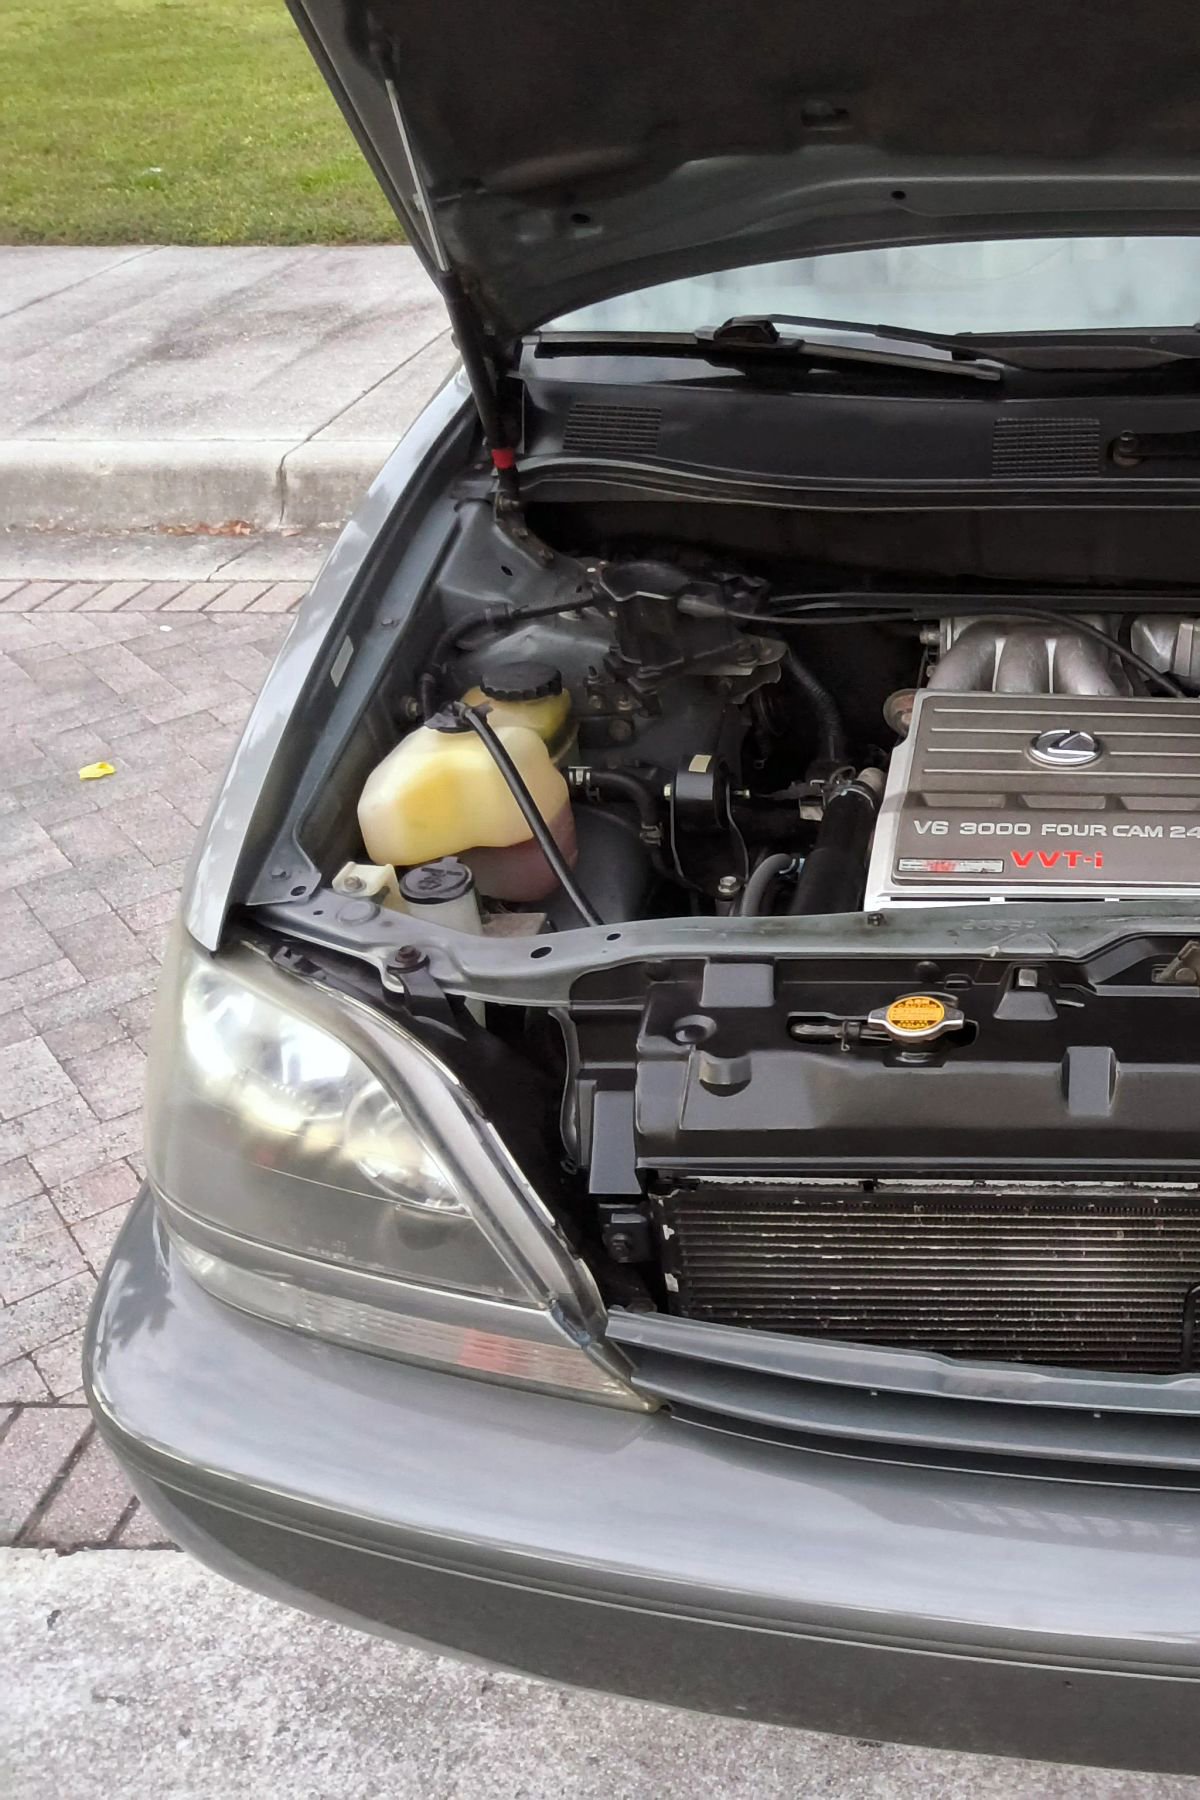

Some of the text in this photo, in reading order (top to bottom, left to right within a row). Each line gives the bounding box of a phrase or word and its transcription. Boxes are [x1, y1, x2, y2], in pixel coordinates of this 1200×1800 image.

[913, 820, 949, 835] V6
[960, 823, 1031, 836] 3000
[1041, 823, 1108, 837] FOUR
[1112, 824, 1163, 838] CAM
[1010, 850, 1104, 869] VVT-i
